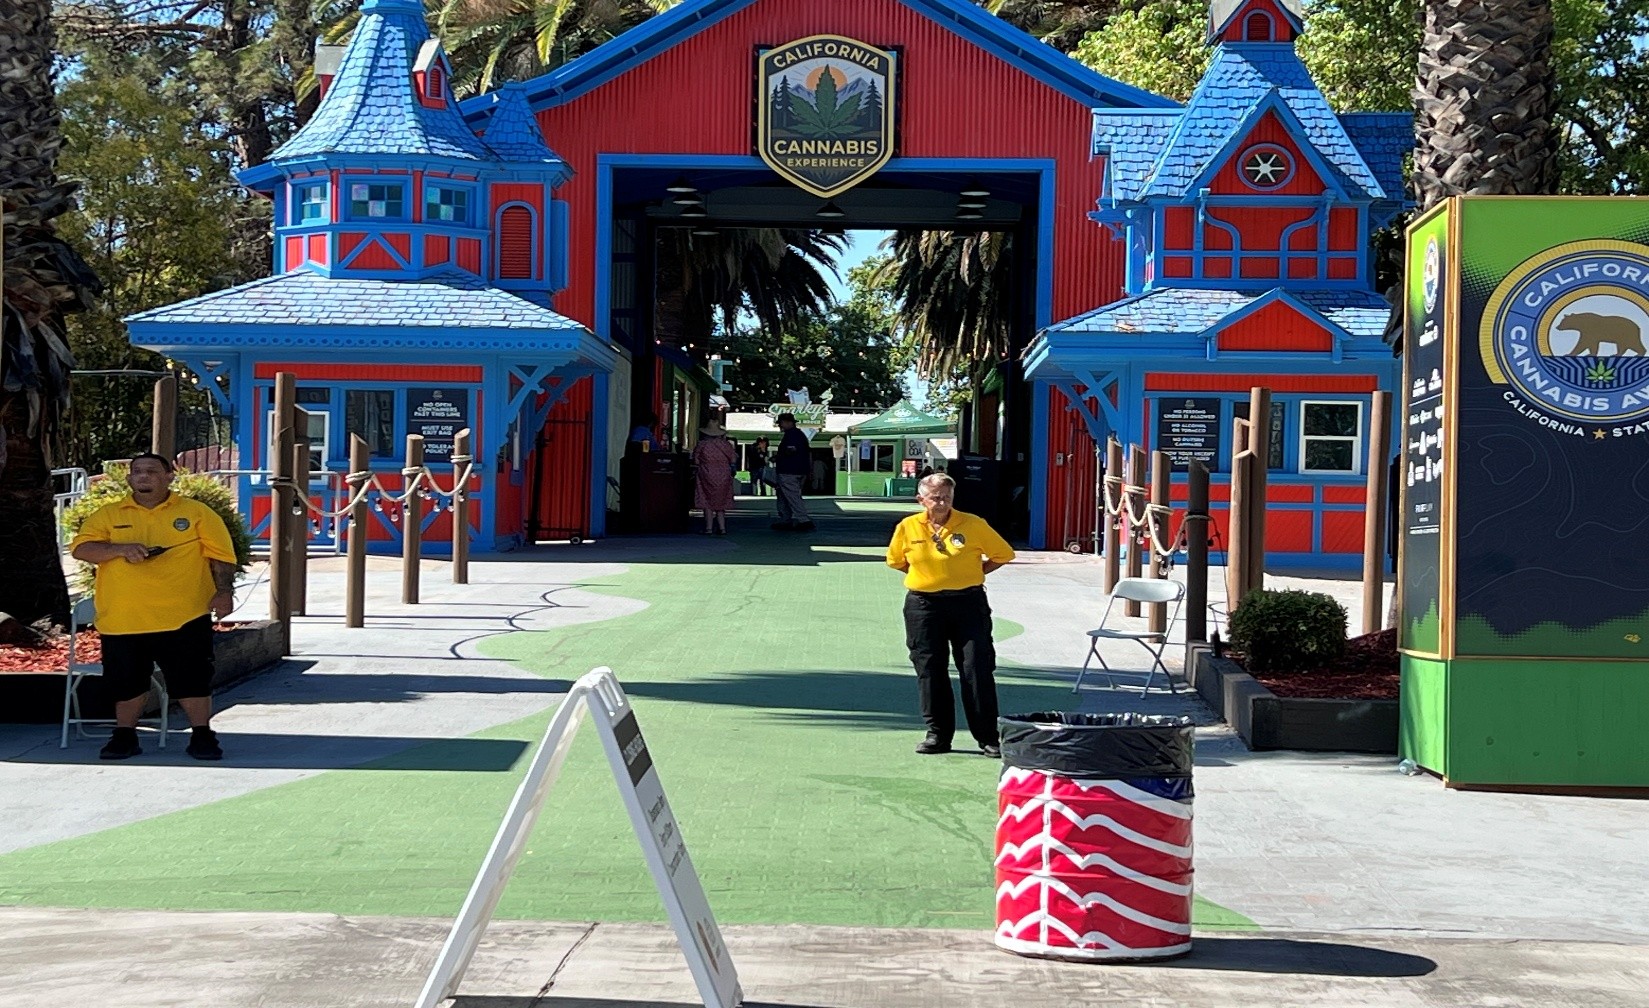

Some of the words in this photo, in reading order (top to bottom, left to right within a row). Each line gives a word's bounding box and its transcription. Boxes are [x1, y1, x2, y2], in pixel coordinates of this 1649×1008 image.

[773, 43, 880, 70] CALIFORNIA
[774, 140, 878, 155] CANNABIS
[787, 158, 865, 168] EXPERIENCE
[1510, 325, 1610, 411] CANNABIS
[1503, 391, 1585, 437] CALIFORNIA
